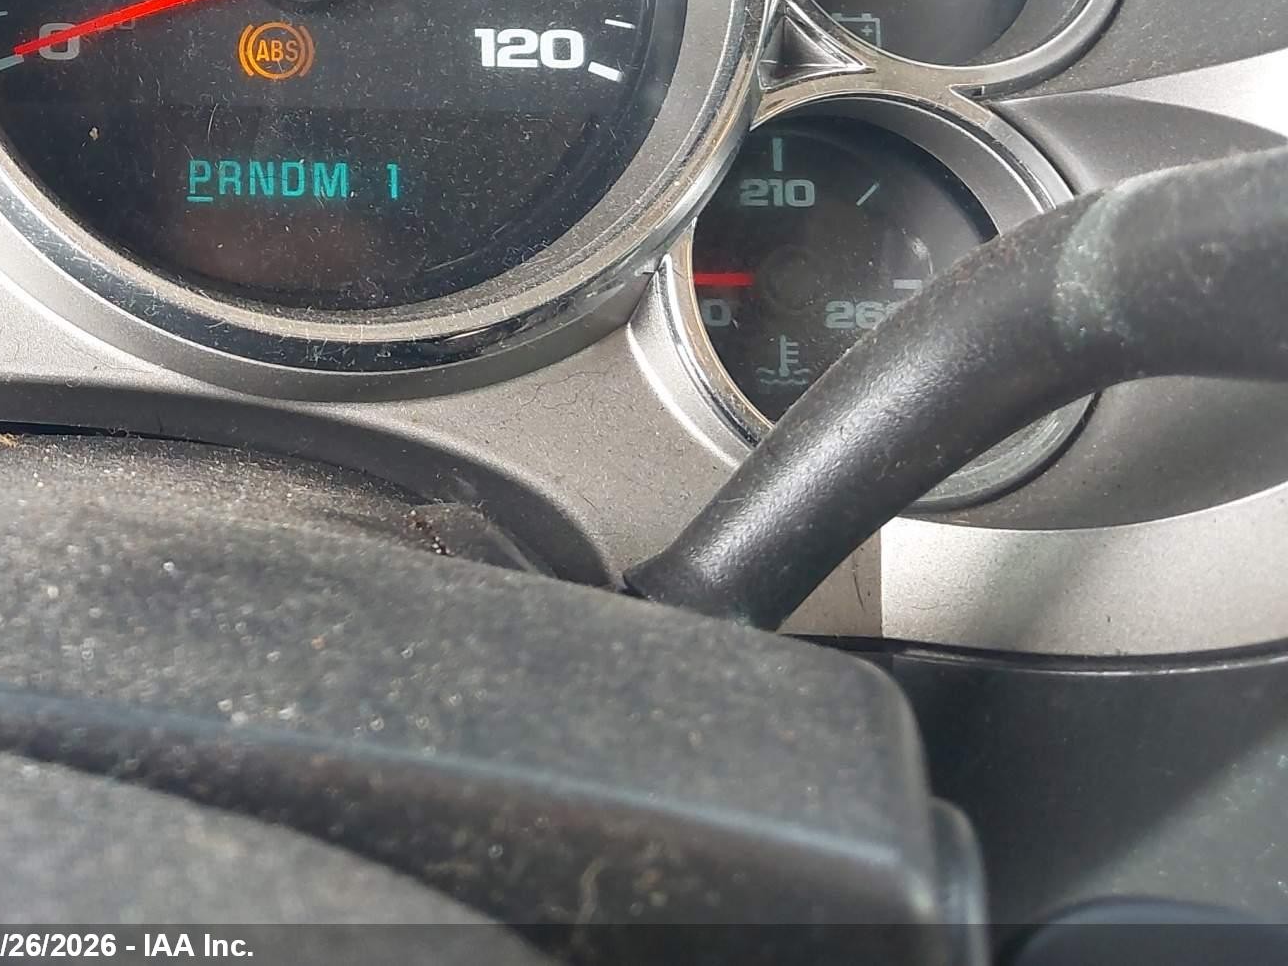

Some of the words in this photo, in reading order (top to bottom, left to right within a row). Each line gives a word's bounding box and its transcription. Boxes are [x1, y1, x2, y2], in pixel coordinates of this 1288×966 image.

[38, 22, 80, 60] 0
[256, 39, 299, 62] ABS
[474, 29, 584, 69] 120
[187, 160, 347, 200] PRNDM
[387, 163, 398, 199] 1
[739, 178, 814, 207] 210
